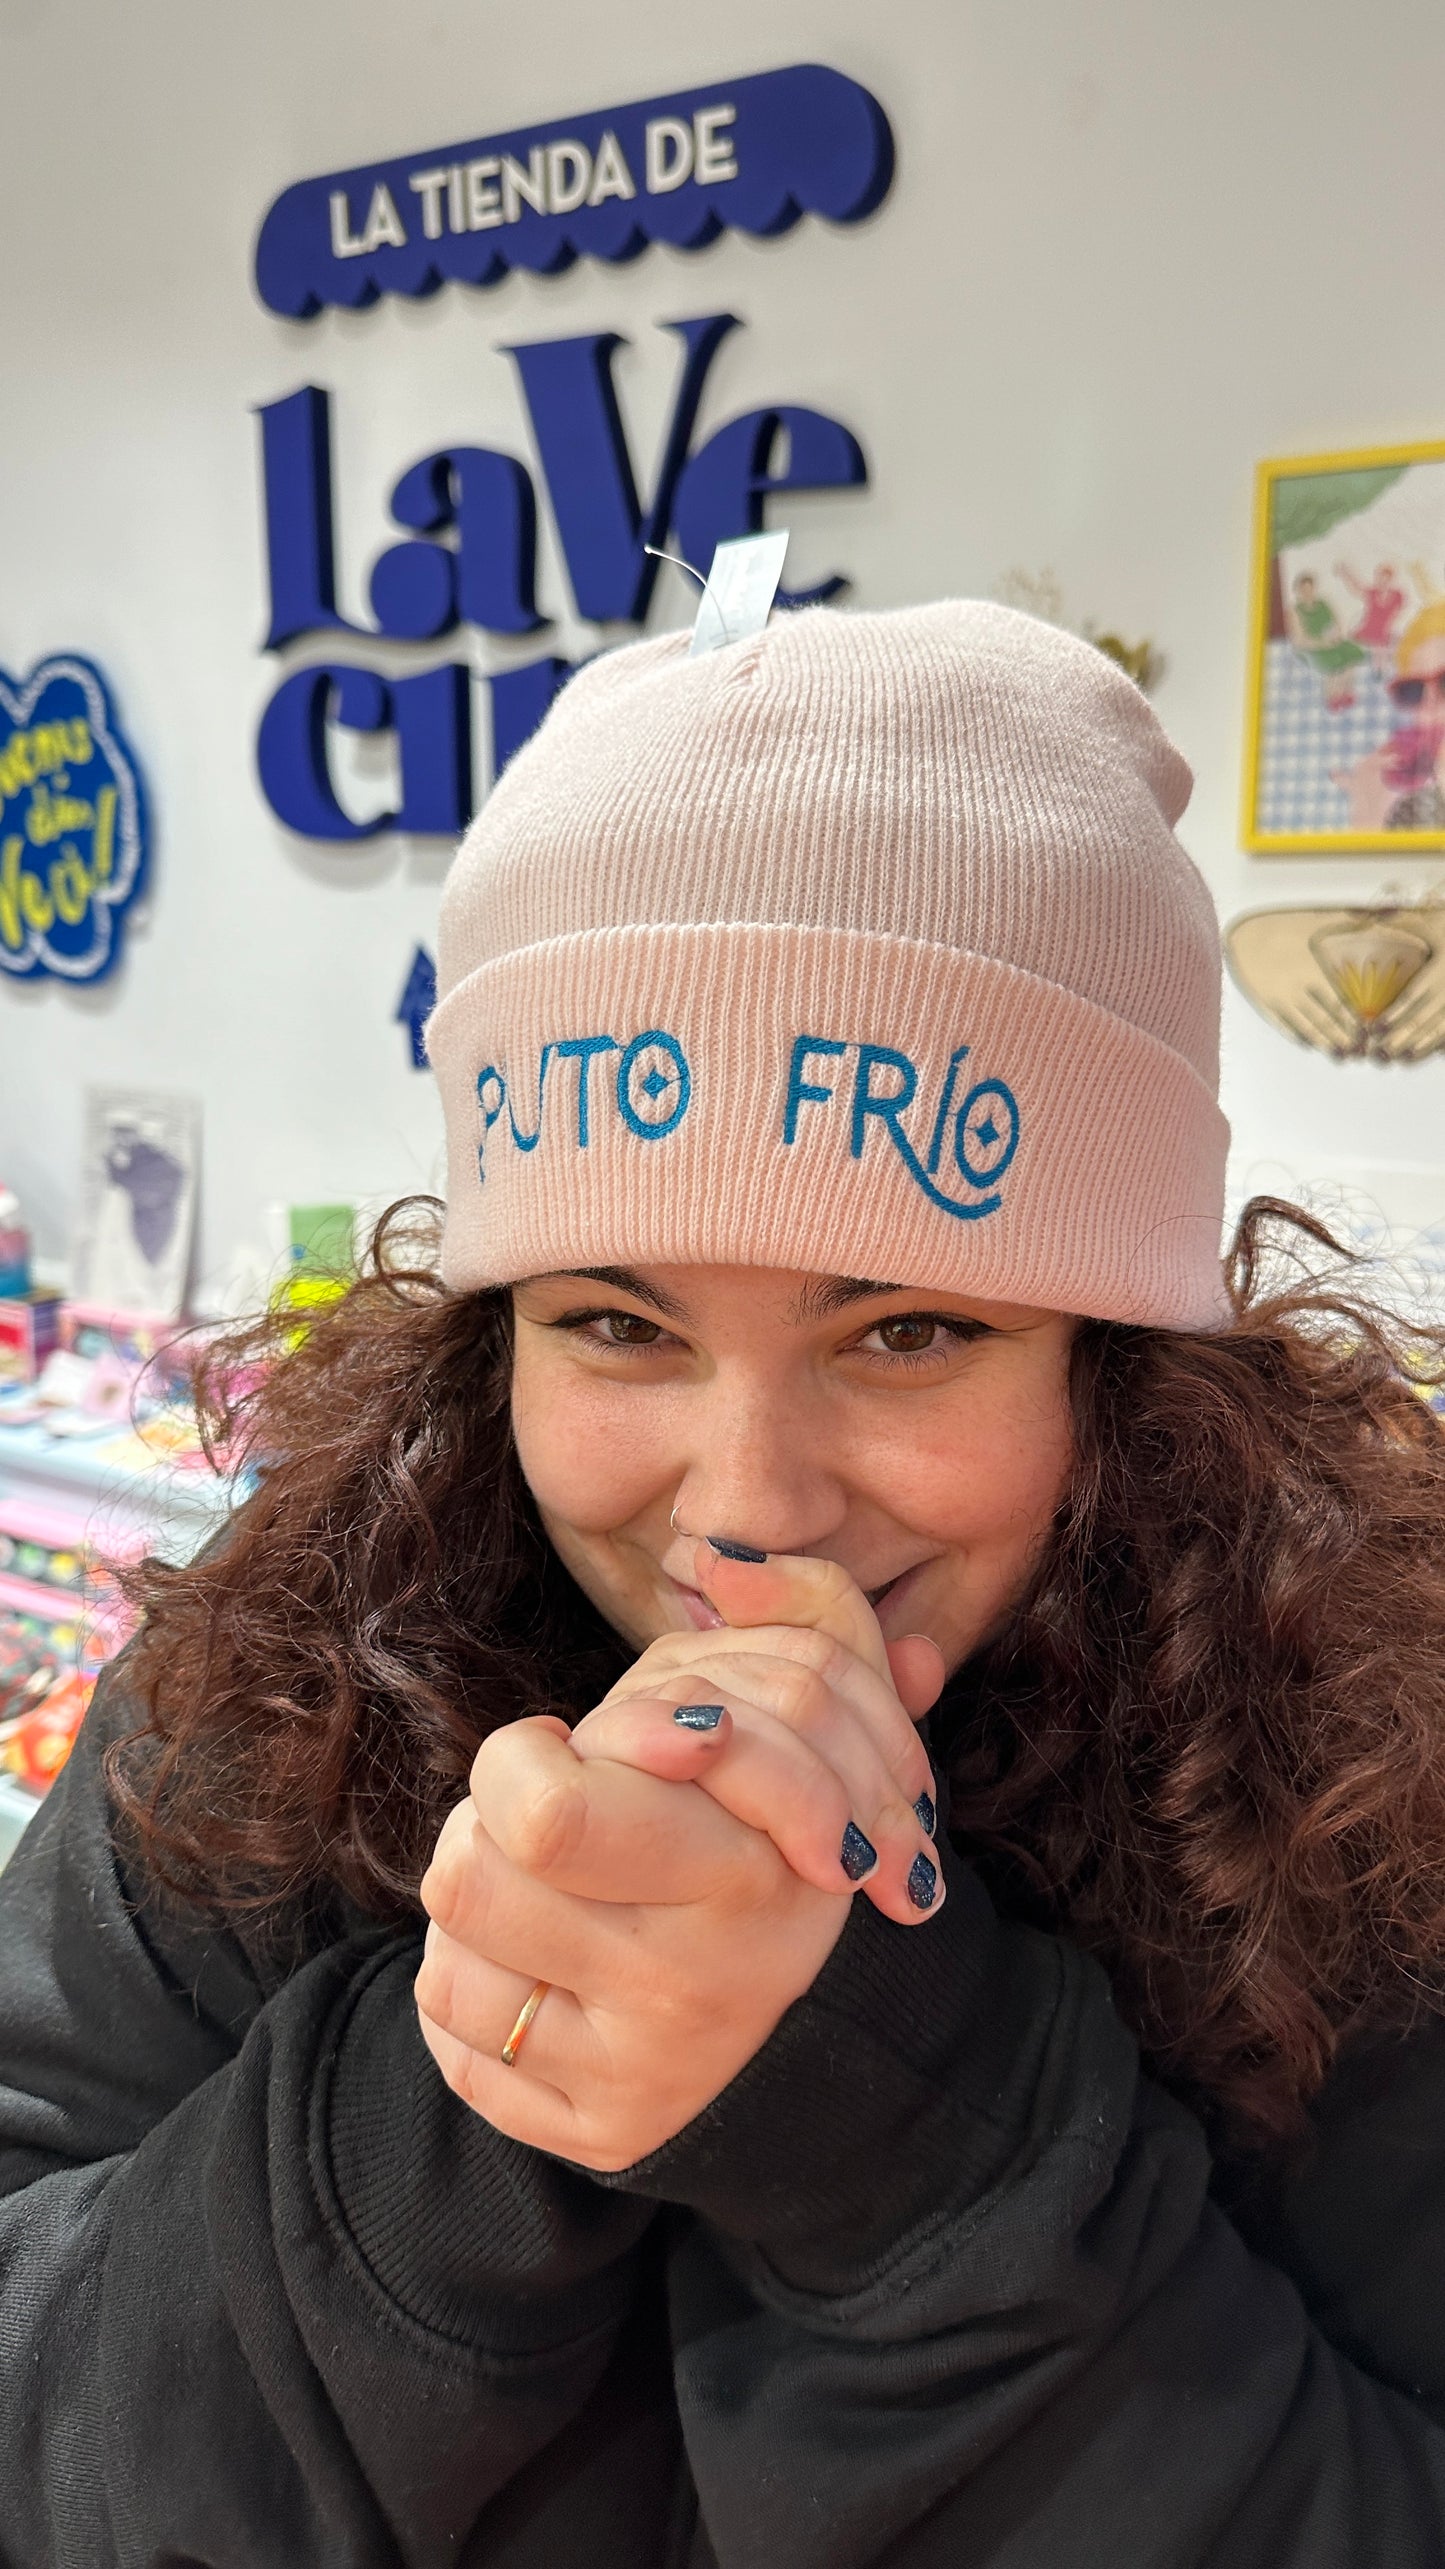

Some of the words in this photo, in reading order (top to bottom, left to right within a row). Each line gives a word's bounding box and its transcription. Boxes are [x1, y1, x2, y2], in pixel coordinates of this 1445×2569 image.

[329, 181, 406, 258] LA
[408, 129, 636, 240] TIENDA
[645, 102, 738, 193] DE
[476, 1029, 692, 1184] PUTO
[782, 1034, 1021, 1220] FRÍO
